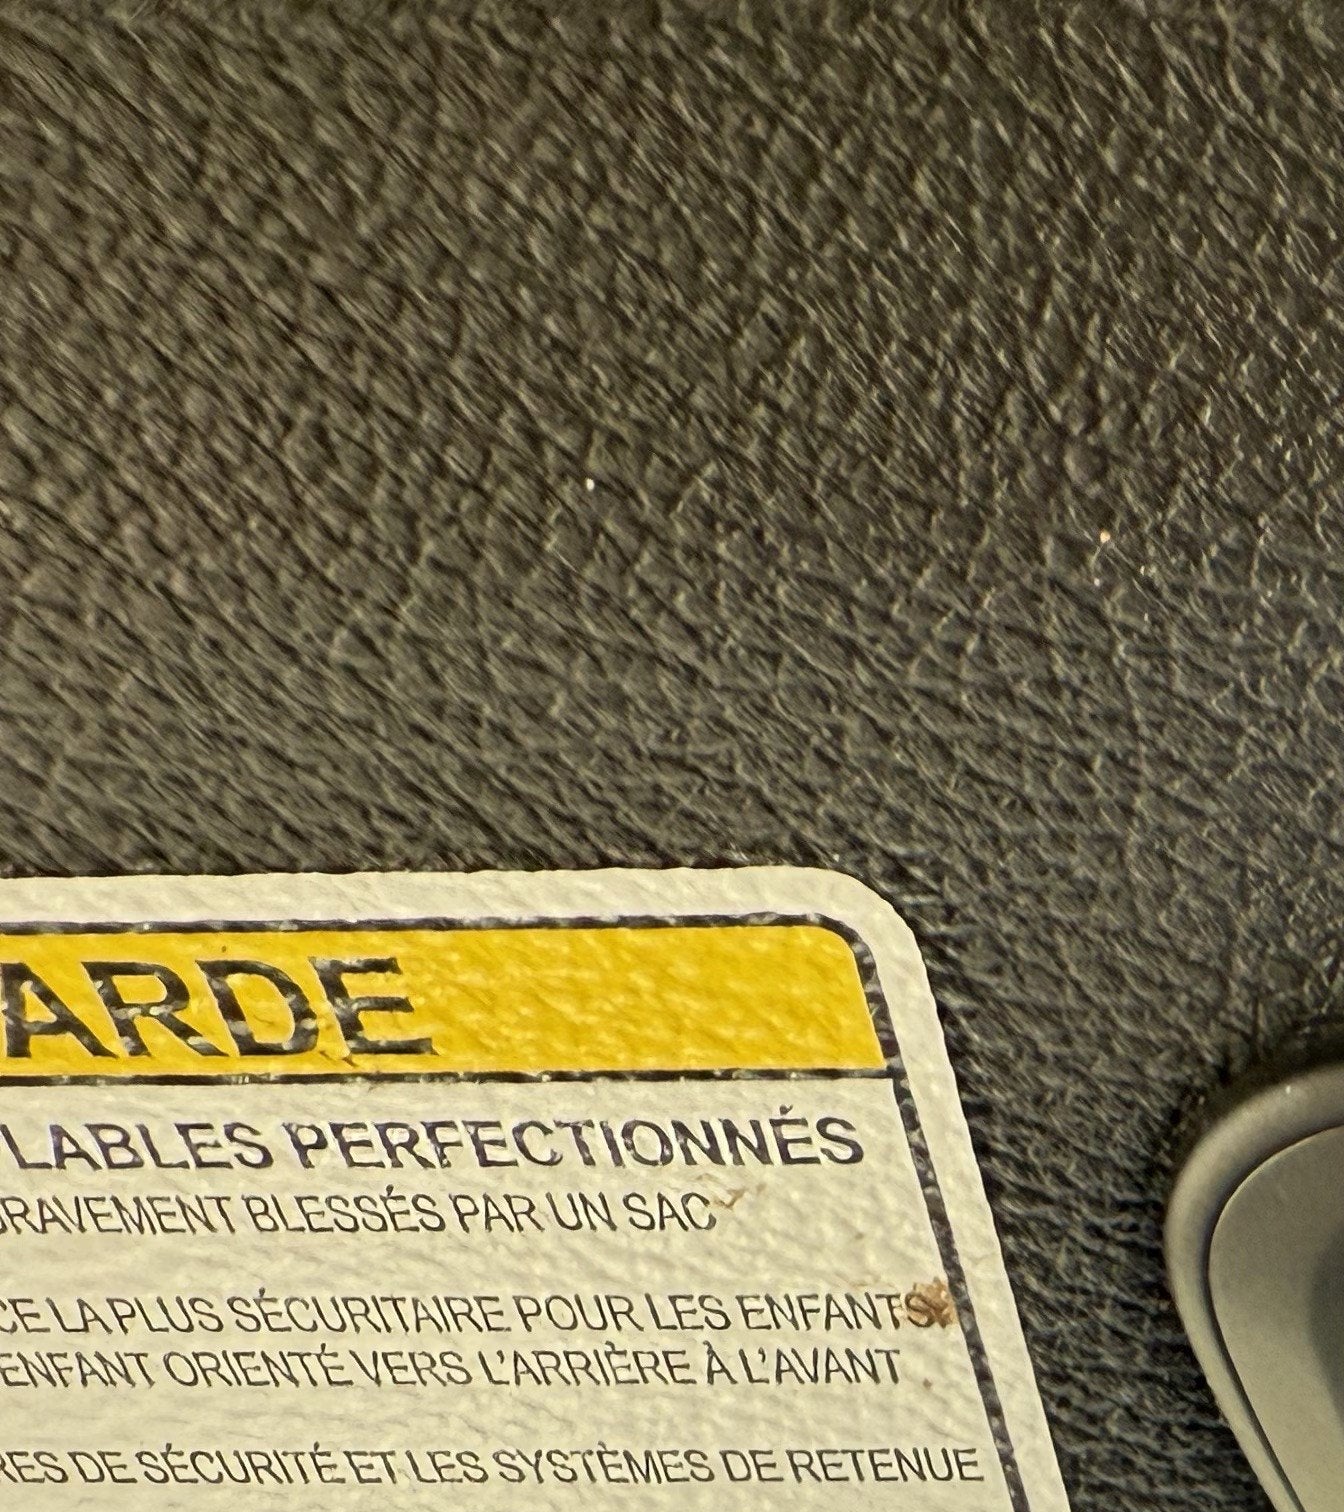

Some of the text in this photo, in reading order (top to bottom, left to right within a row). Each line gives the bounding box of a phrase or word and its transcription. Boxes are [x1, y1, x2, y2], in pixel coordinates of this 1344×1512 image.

[0, 957, 440, 1058] ARDE
[1, 1104, 865, 1171] LABLES PERFECTIONNÉS
[0, 1184, 717, 1235] RAVEMENT BLESSÉS PAR UN SAC
[46, 1296, 113, 1335] LA
[106, 1296, 224, 1336] PLUS
[229, 1286, 511, 1335] SÉCURITAIRE
[512, 1294, 644, 1333] POUR
[643, 1293, 732, 1332] LES
[736, 1291, 938, 1331] ENFANTS
[0, 1339, 900, 1388] ENFANT ORIENTÉ VERS L'ARRIÈRE À L'AVANT
[67, 1451, 138, 1484] DE
[135, 1441, 346, 1485] SÉCURITÉ
[344, 1450, 400, 1485] ET
[404, 1450, 490, 1485] LES
[492, 1440, 716, 1484] SYSTÈMES
[719, 1449, 788, 1483] DE
[785, 1447, 985, 1483] RETENUE
